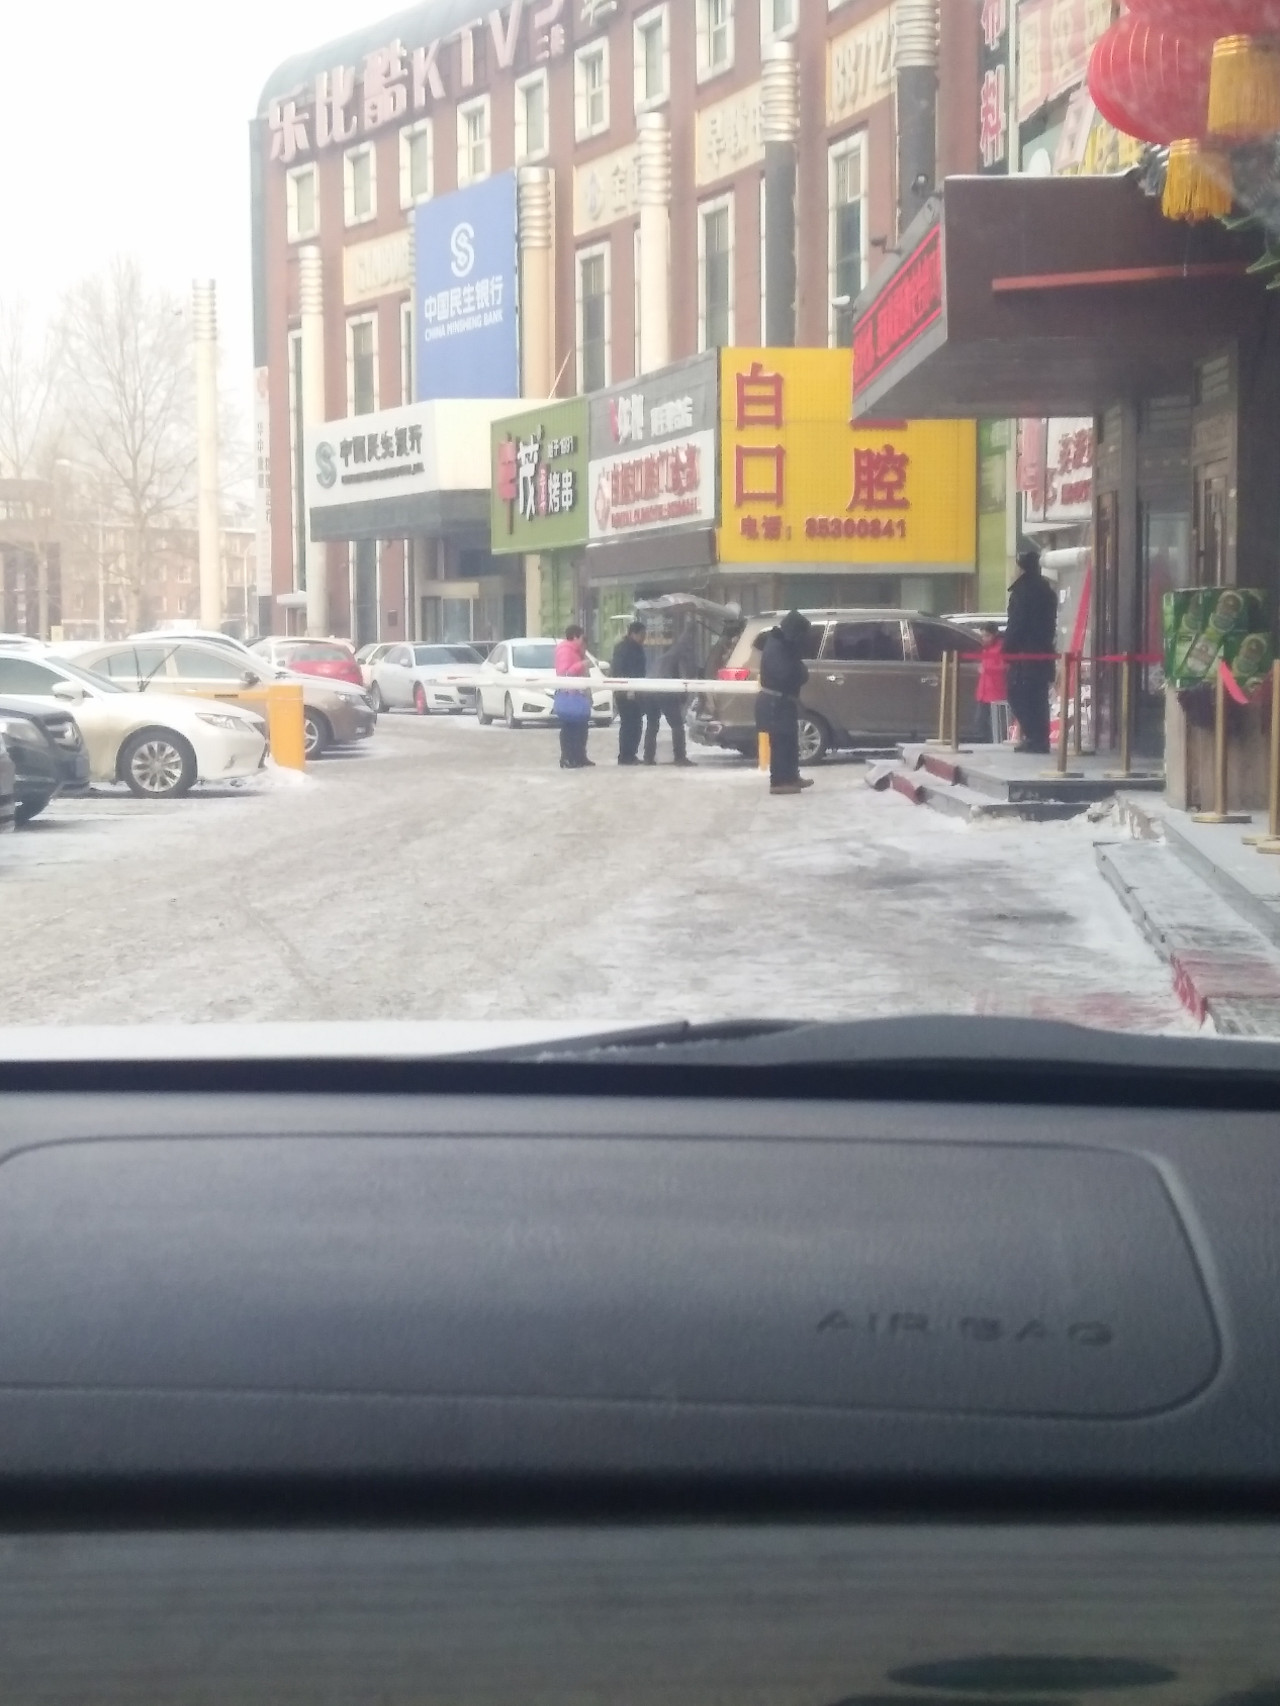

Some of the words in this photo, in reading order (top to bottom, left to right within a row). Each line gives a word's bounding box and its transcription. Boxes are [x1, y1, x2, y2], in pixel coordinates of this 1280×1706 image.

[424, 275, 504, 324] 中国民生银行
[424, 324, 446, 342] CHINA
[483, 308, 504, 326] BANK
[547, 469, 575, 513] 烤串
